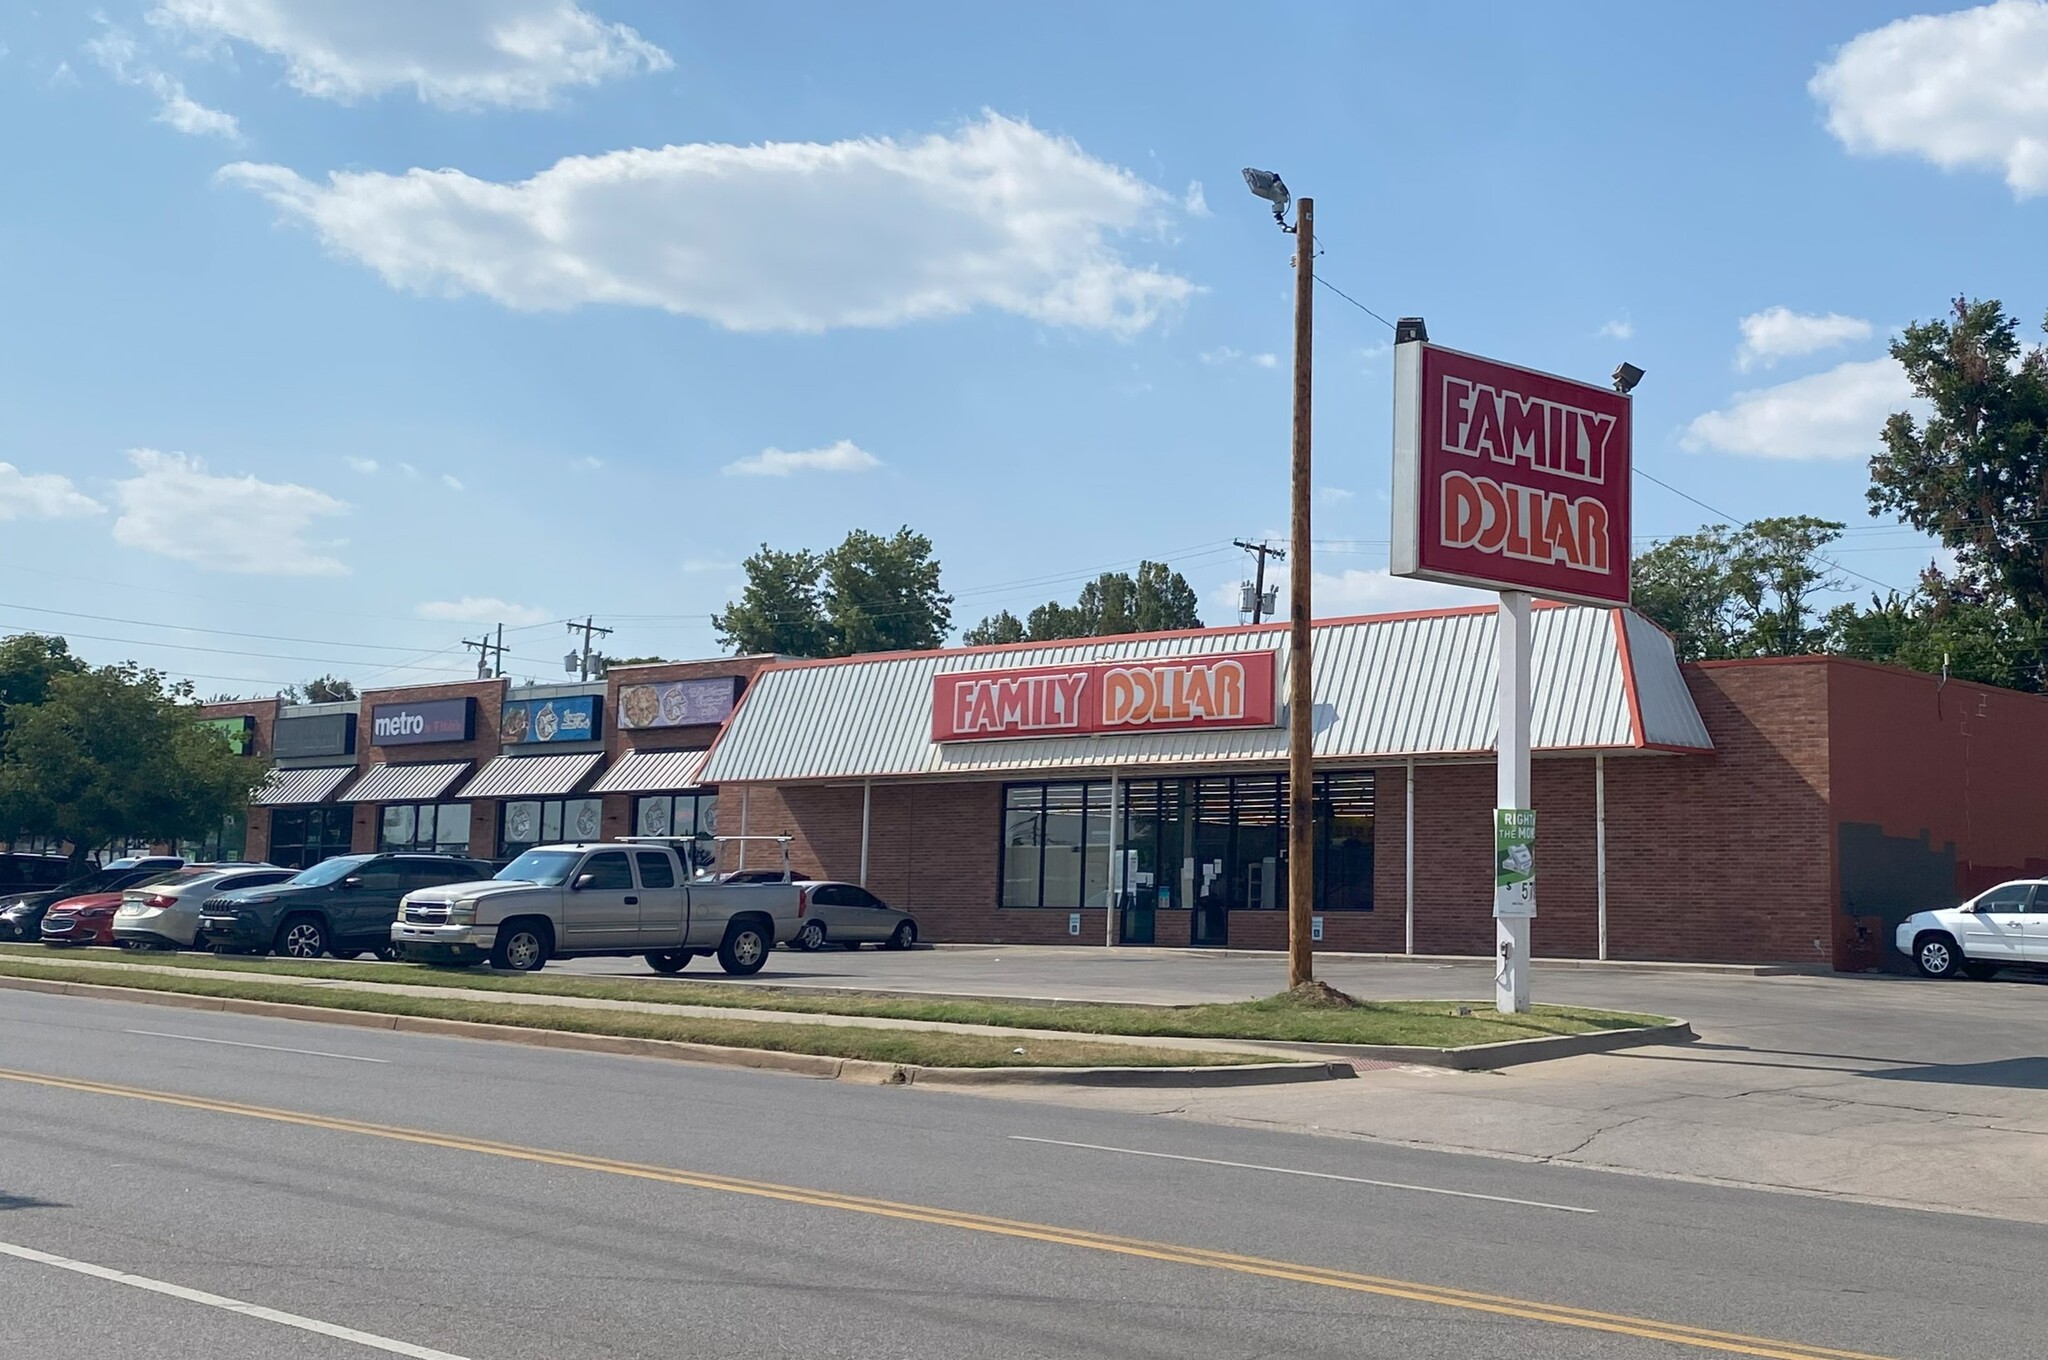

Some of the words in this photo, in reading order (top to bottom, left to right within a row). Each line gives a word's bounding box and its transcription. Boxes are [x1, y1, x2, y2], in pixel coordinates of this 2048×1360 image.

[1441, 375, 1617, 485] FAMILY
[1440, 470, 1610, 574] DOLLAR
[375, 711, 424, 737] metro
[953, 672, 1088, 734] FAMILY
[1102, 660, 1245, 726] DOLLAR
[1498, 829, 1516, 839] THE
